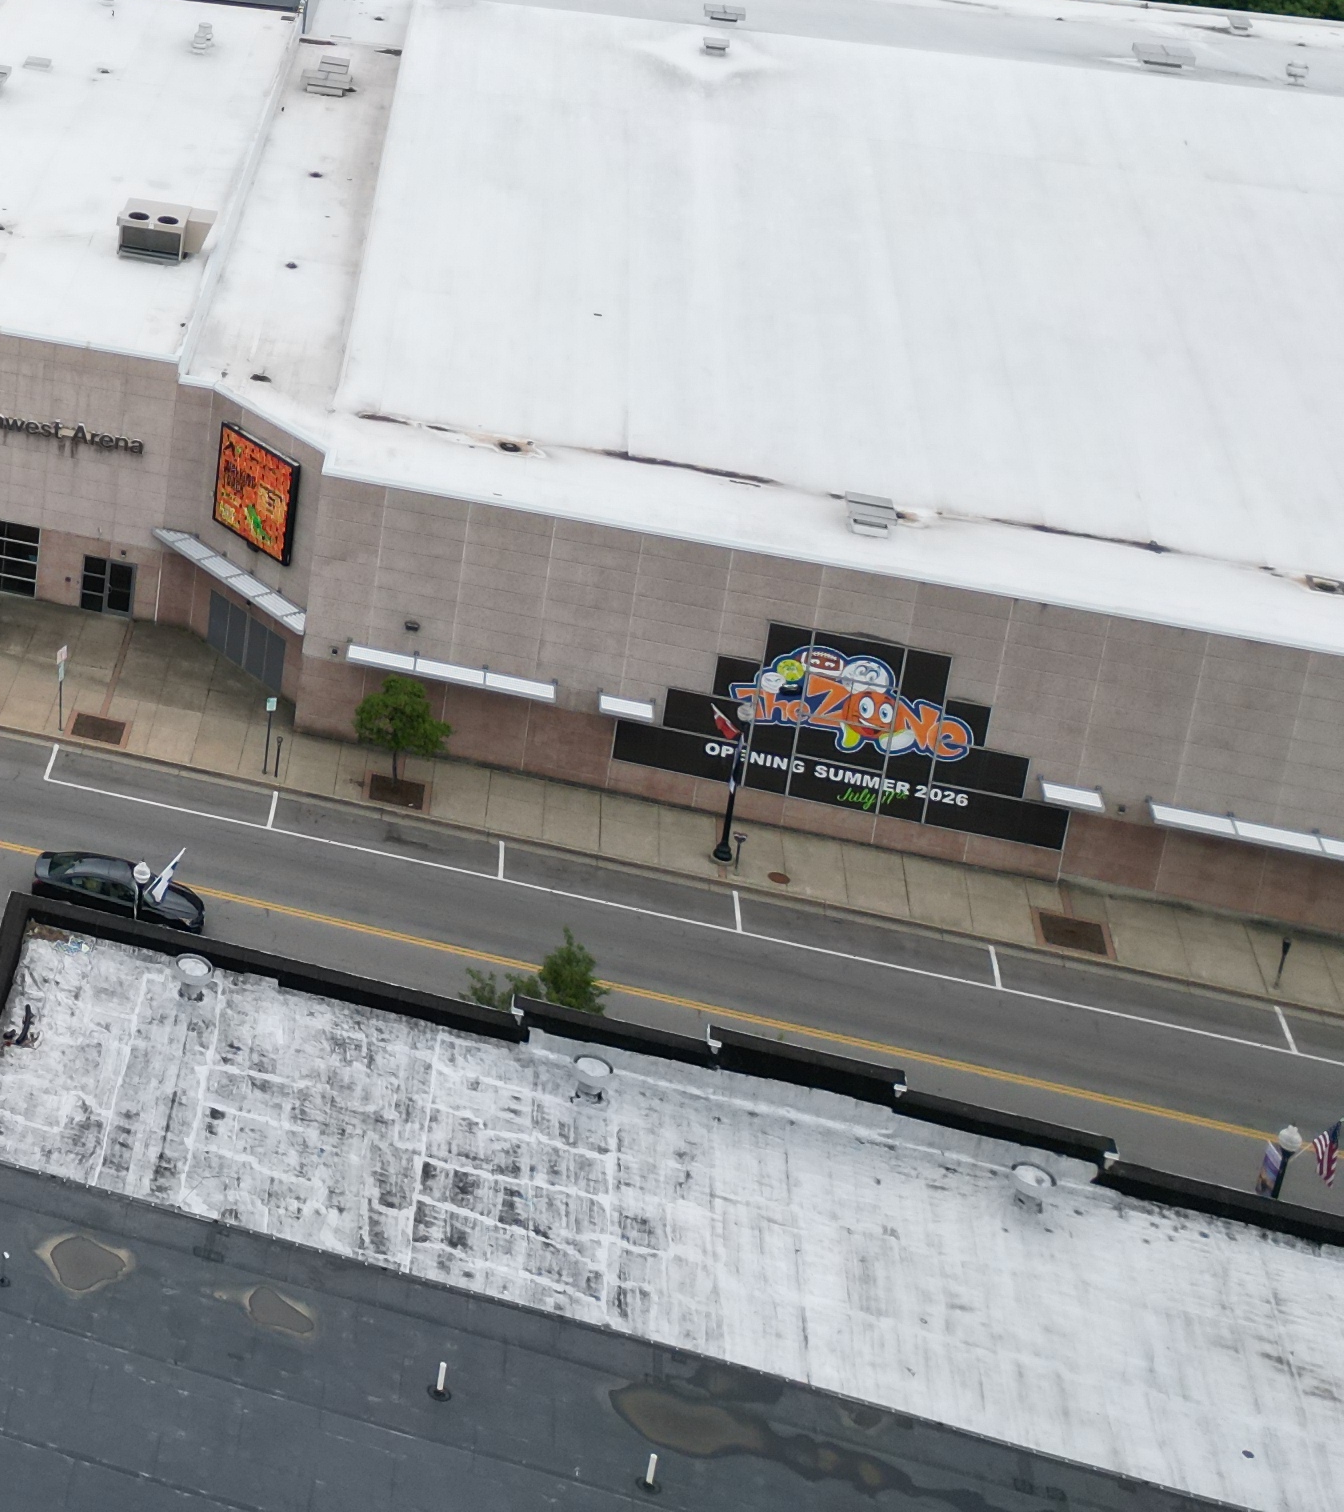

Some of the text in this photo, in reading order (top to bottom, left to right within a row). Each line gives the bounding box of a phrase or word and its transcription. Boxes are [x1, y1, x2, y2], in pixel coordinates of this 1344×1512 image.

[71, 422, 145, 455] Arena
[814, 764, 911, 796] SUMMER
[914, 784, 969, 807] 2026
[836, 787, 876, 810] July
